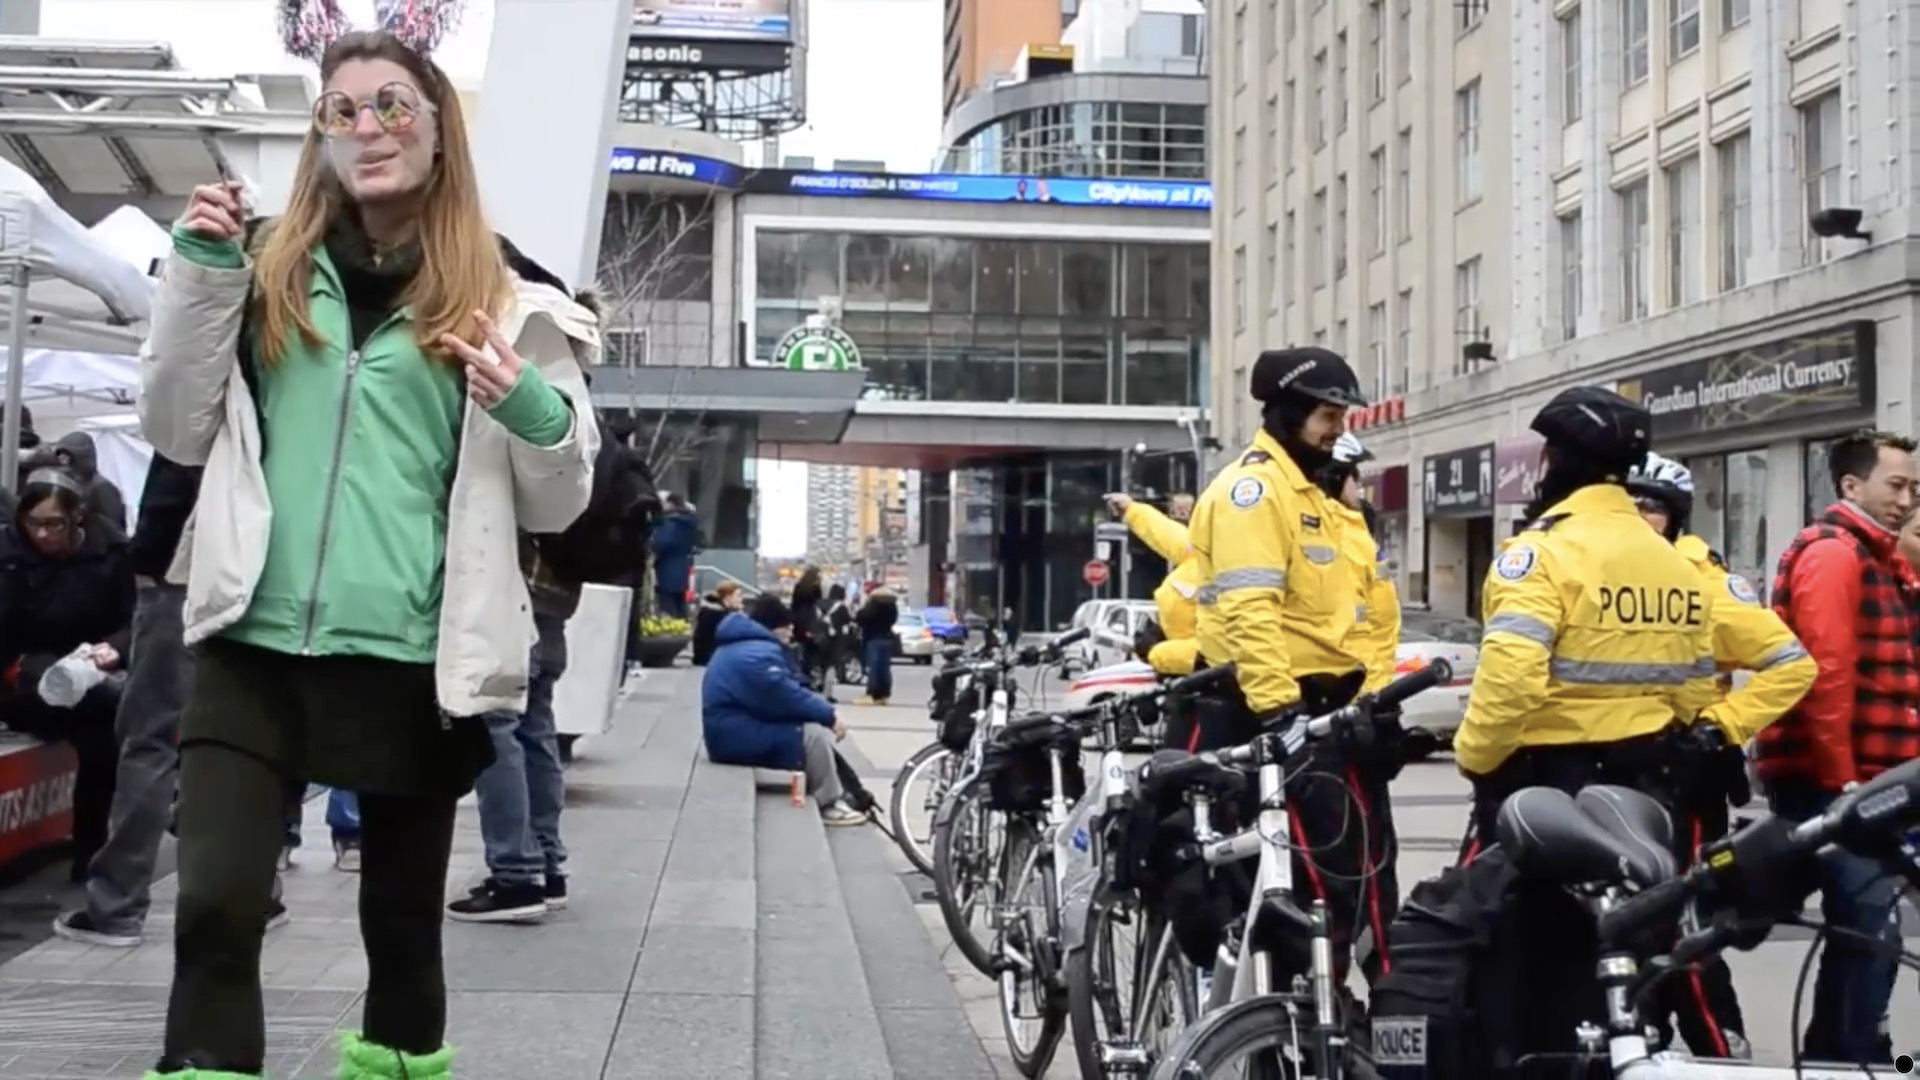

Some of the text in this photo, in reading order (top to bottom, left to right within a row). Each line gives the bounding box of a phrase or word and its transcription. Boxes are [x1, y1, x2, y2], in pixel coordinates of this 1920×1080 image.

[627, 45, 702, 62] asonic
[636, 155, 658, 170] at
[659, 156, 696, 177] Five
[1088, 182, 1168, 204] CityNews
[1170, 186, 1191, 203] at
[1698, 363, 1782, 406] International
[1783, 357, 1854, 390] Currency
[1598, 585, 1702, 625] POLICE
